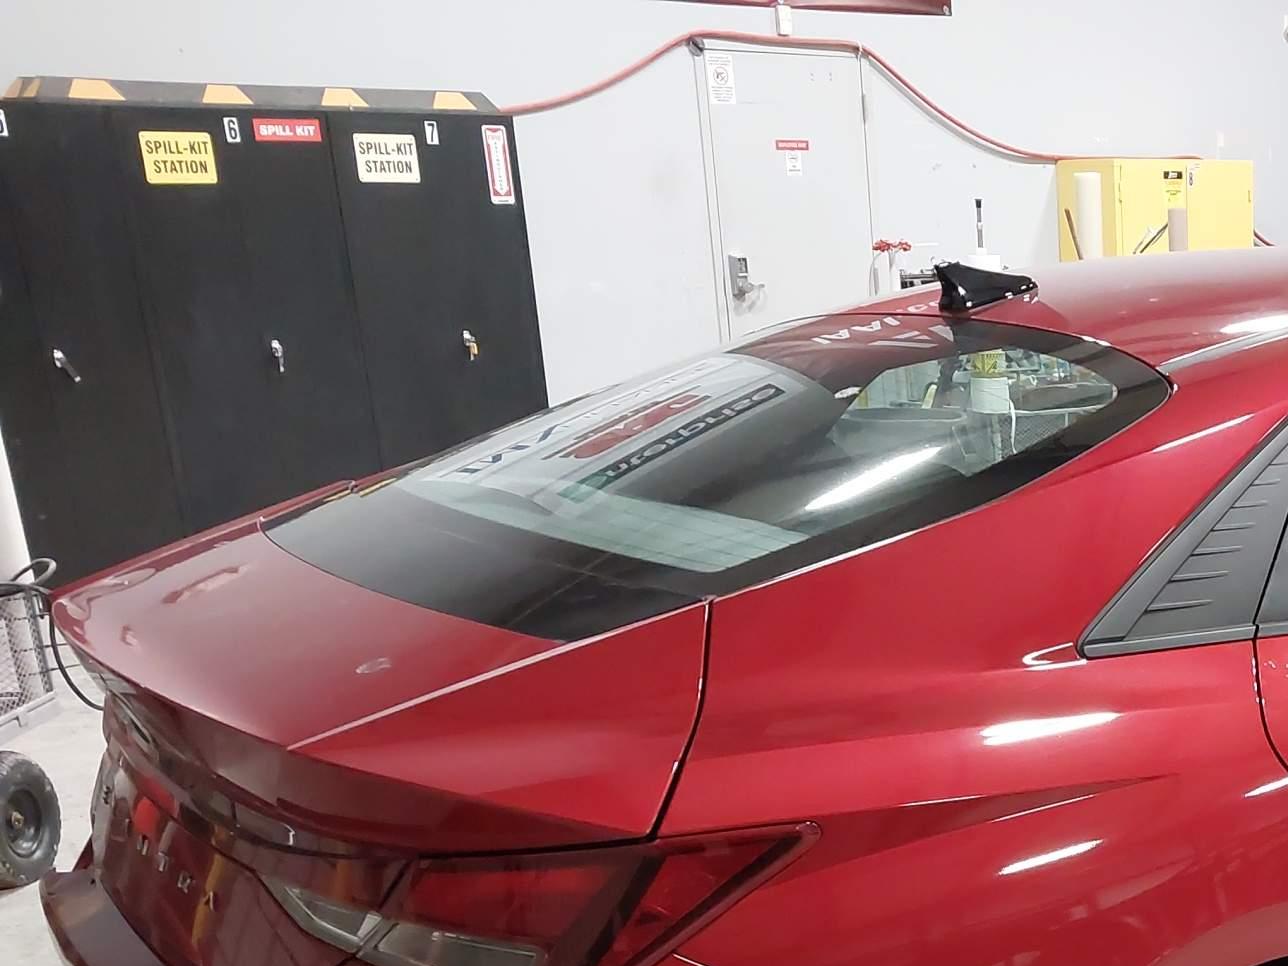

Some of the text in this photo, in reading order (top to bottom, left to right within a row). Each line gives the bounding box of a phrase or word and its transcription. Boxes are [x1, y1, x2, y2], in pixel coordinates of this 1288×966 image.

[227, 119, 239, 140] 6
[259, 124, 316, 137] SPILL KIT
[426, 123, 436, 143] 7
[145, 140, 209, 155] SPILL-KIT
[358, 141, 414, 156] SPILL-KIT
[154, 159, 209, 174] STATION
[365, 160, 413, 174] STATION
